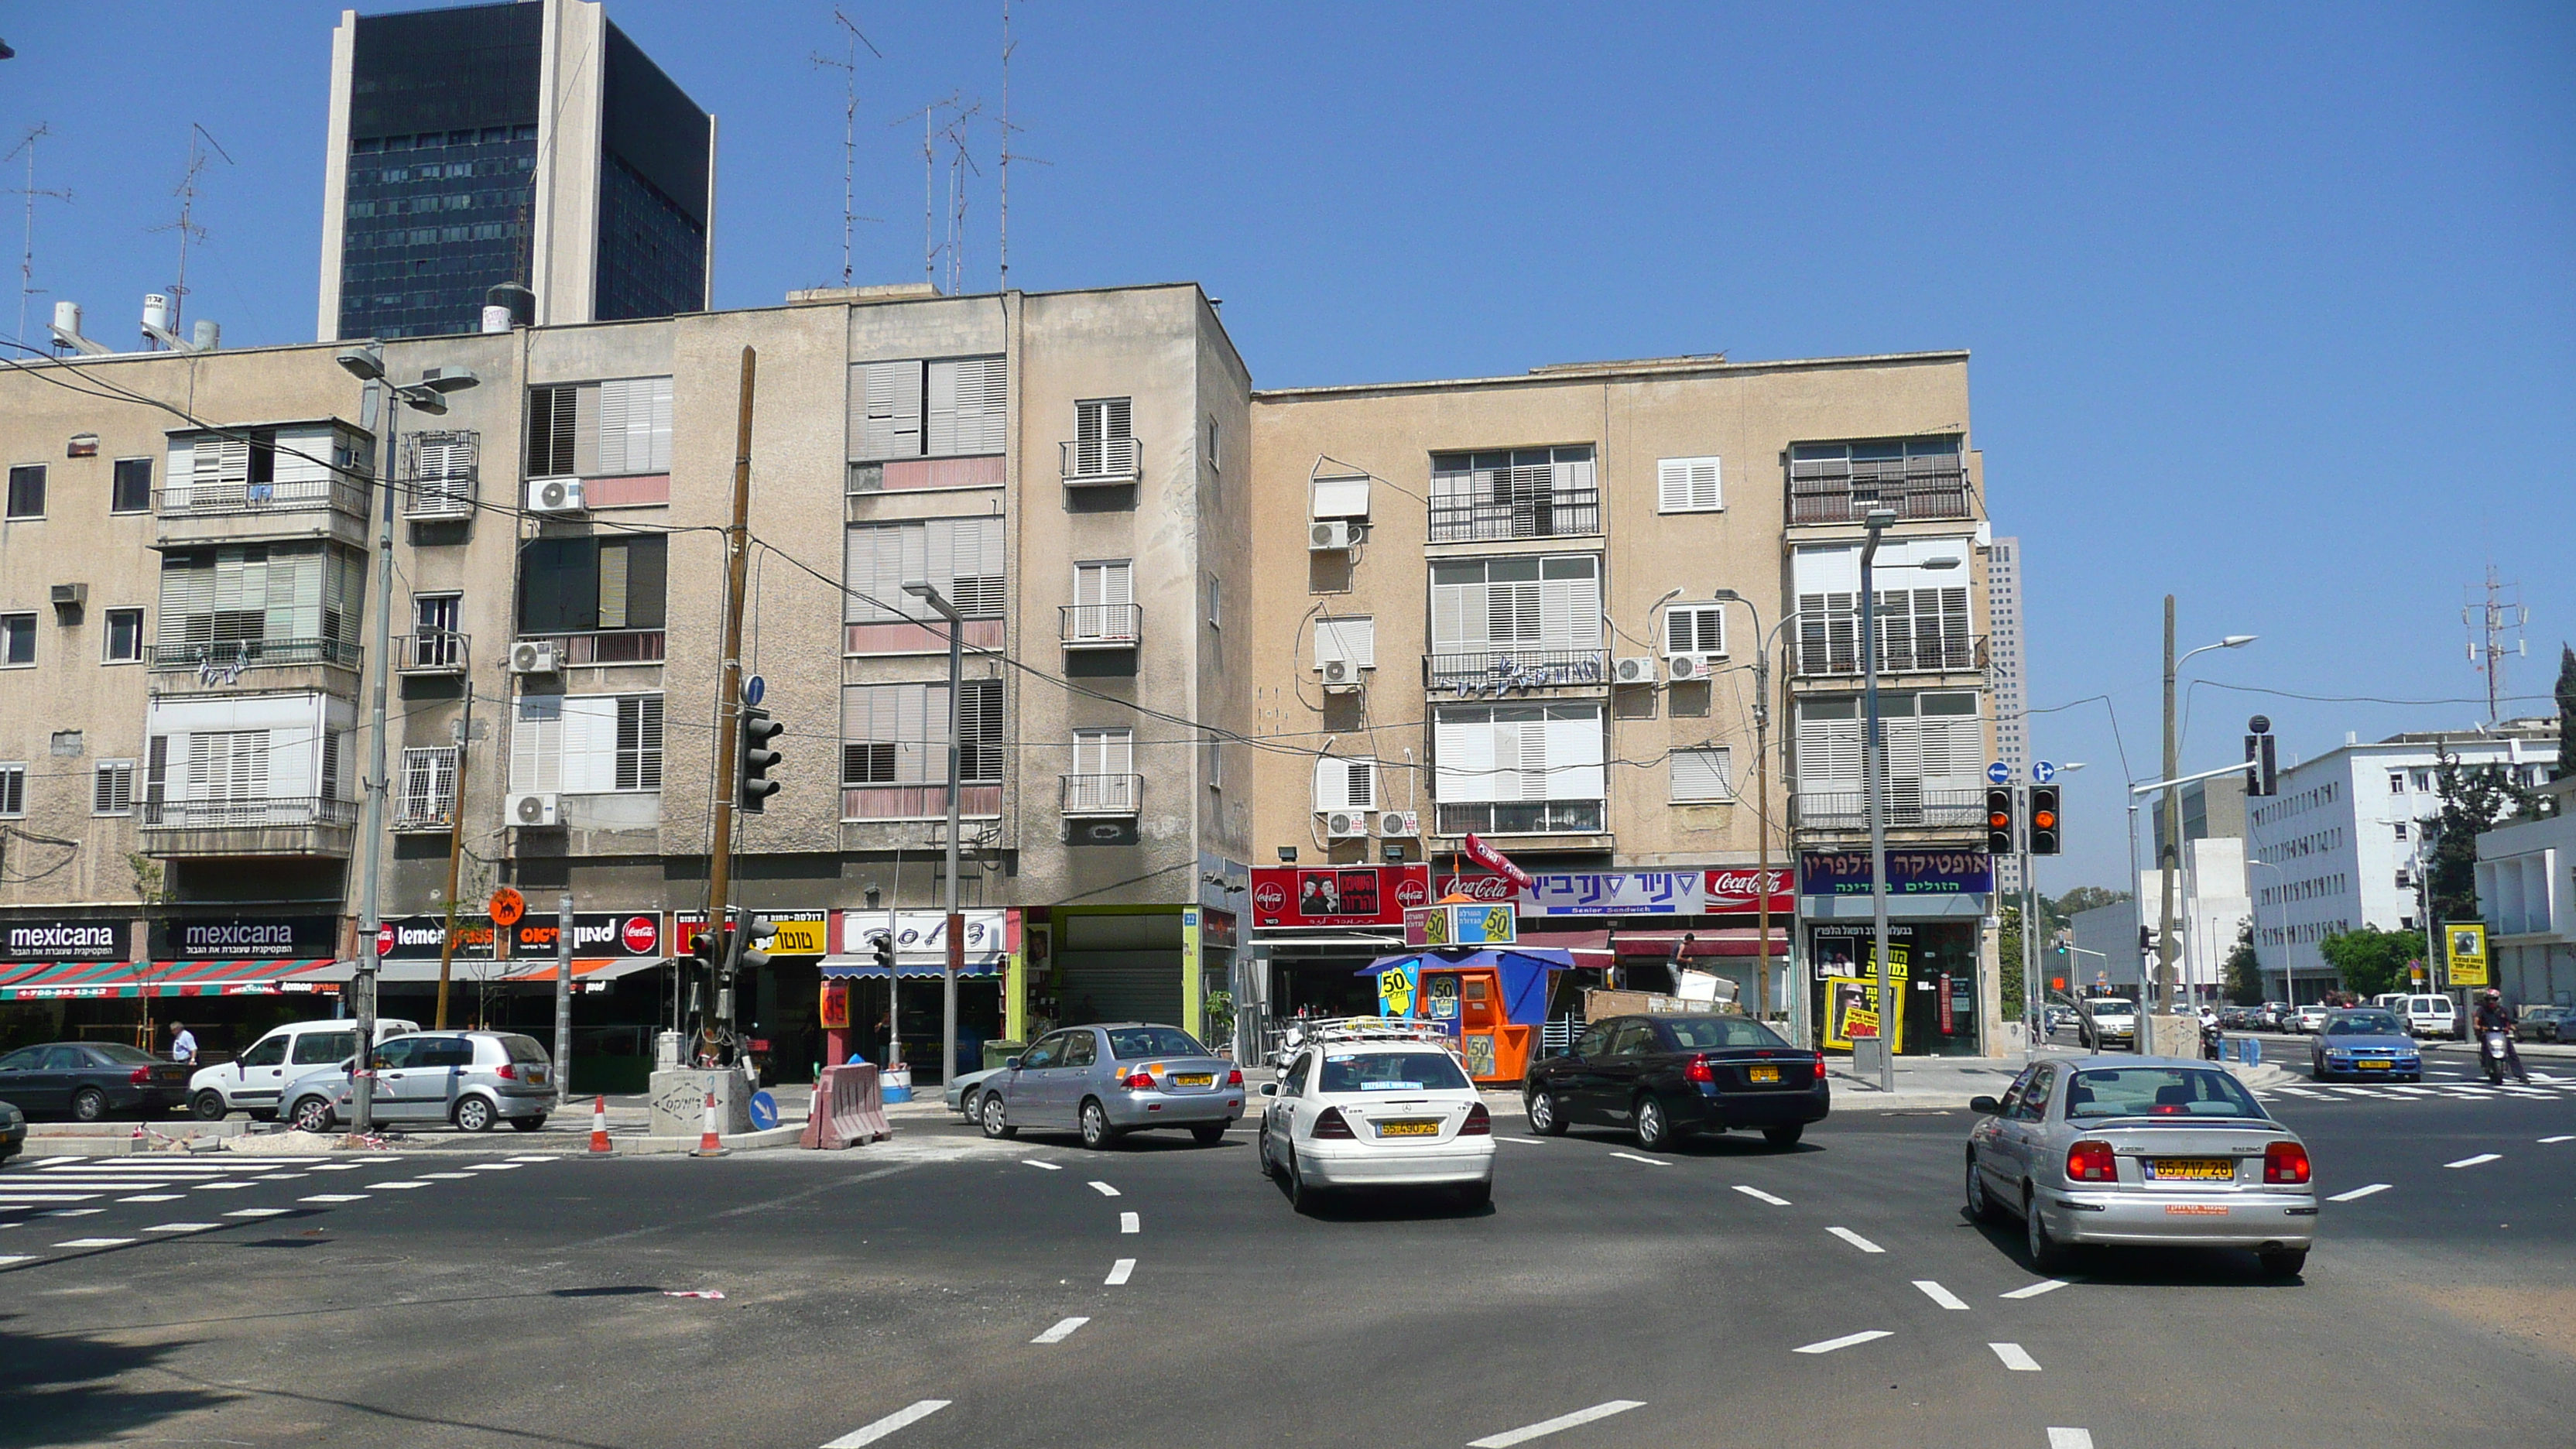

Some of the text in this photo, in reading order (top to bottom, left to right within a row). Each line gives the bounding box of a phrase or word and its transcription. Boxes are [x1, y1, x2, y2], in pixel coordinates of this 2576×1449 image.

[1893, 854, 1989, 880] אופטיקה
[1340, 875, 1375, 894] השמן
[1444, 876, 1509, 899] Coca-Cola
[1835, 881, 1959, 892] הזולים בדינה
[1341, 895, 1376, 912] והרזה
[1606, 905, 1651, 913] Sandwich
[1187, 915, 1195, 923] 22
[1427, 913, 1444, 936] 50
[1487, 911, 1508, 933] 50
[11, 923, 113, 946] mexicana
[187, 920, 292, 944] mexicana
[1841, 926, 1864, 935] רפאל
[1887, 925, 1913, 935] בבעלו
[778, 932, 814, 950] טוטו
[11, 947, 30, 956] הגבול
[74, 947, 113, 956] המקסיקנית
[252, 945, 292, 954] המקסיקנית
[1382, 973, 1405, 993] 50
[1434, 984, 1453, 998] 50
[1471, 1042, 1488, 1056] 50
